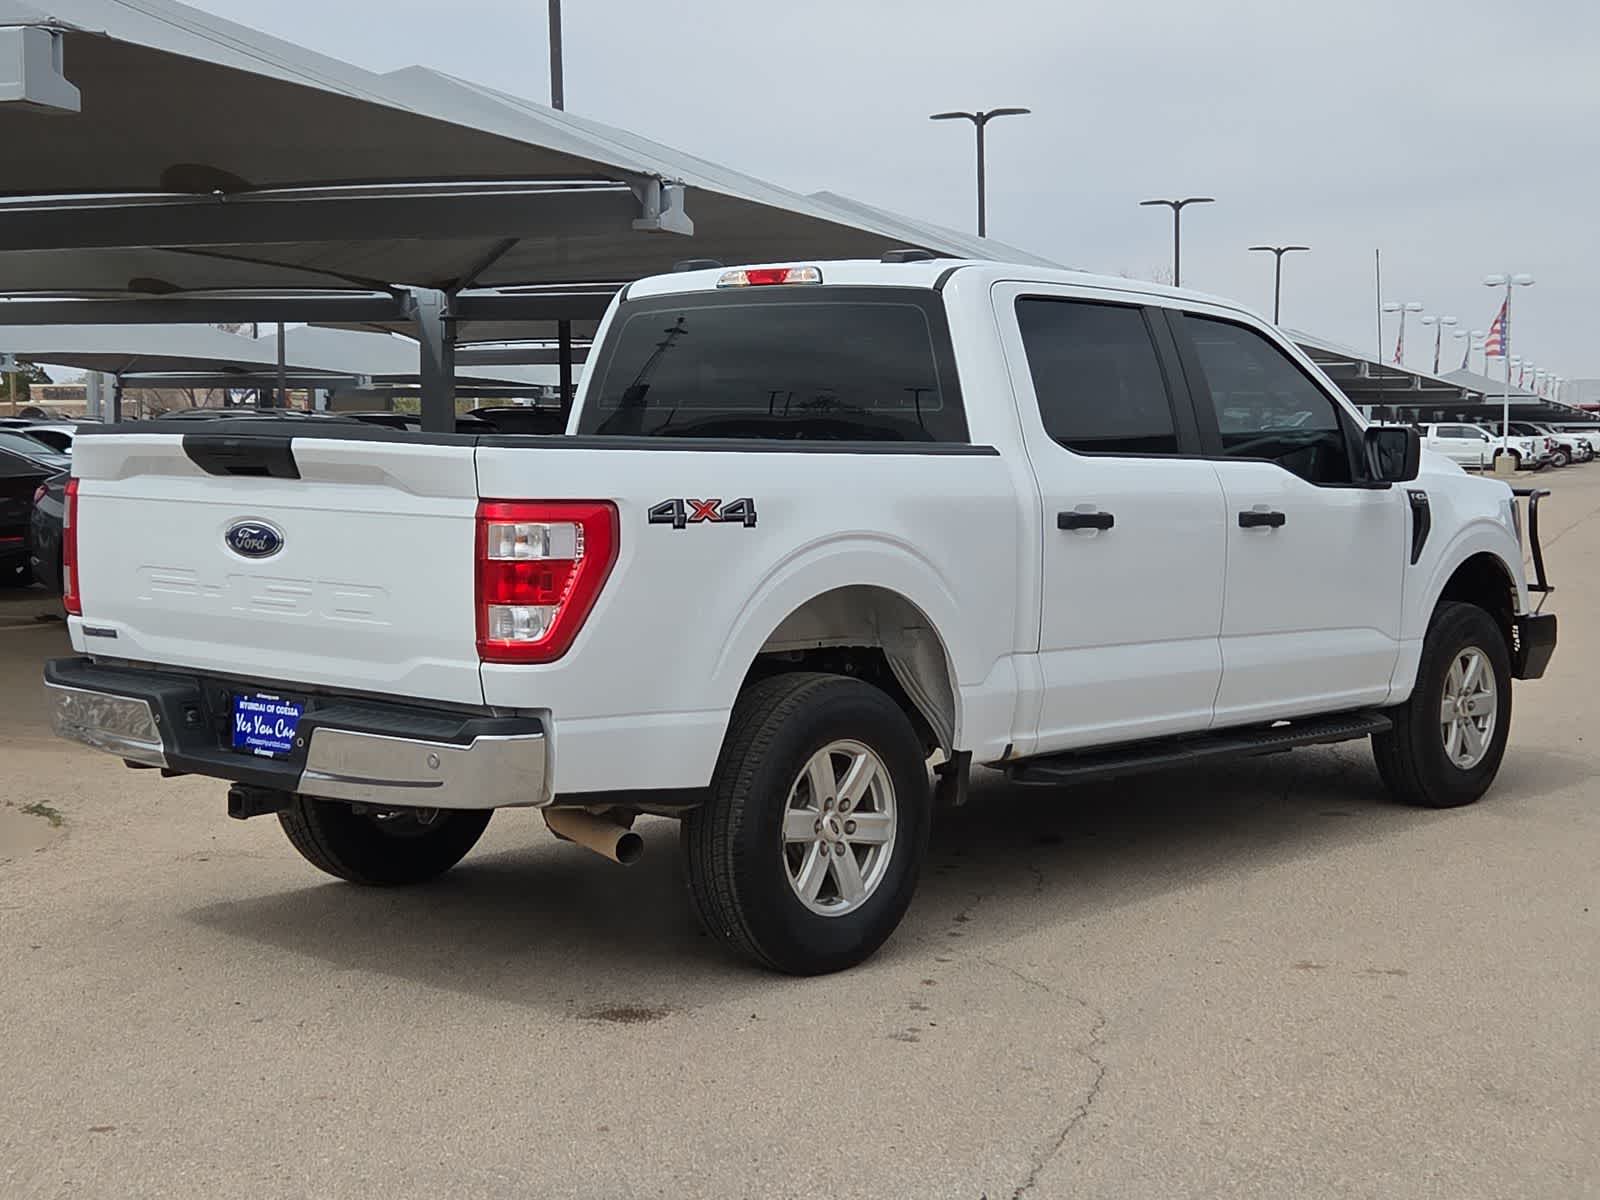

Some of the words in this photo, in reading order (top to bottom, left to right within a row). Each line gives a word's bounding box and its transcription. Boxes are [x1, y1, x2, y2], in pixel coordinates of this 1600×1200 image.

[234, 526, 268, 551] Ford
[240, 701, 265, 712] HYUNDAI
[266, 704, 275, 713] OF
[276, 706, 298, 716] ODESSA
[236, 713, 252, 734] Yes
[254, 715, 273, 735] You
[275, 719, 296, 739] Can
